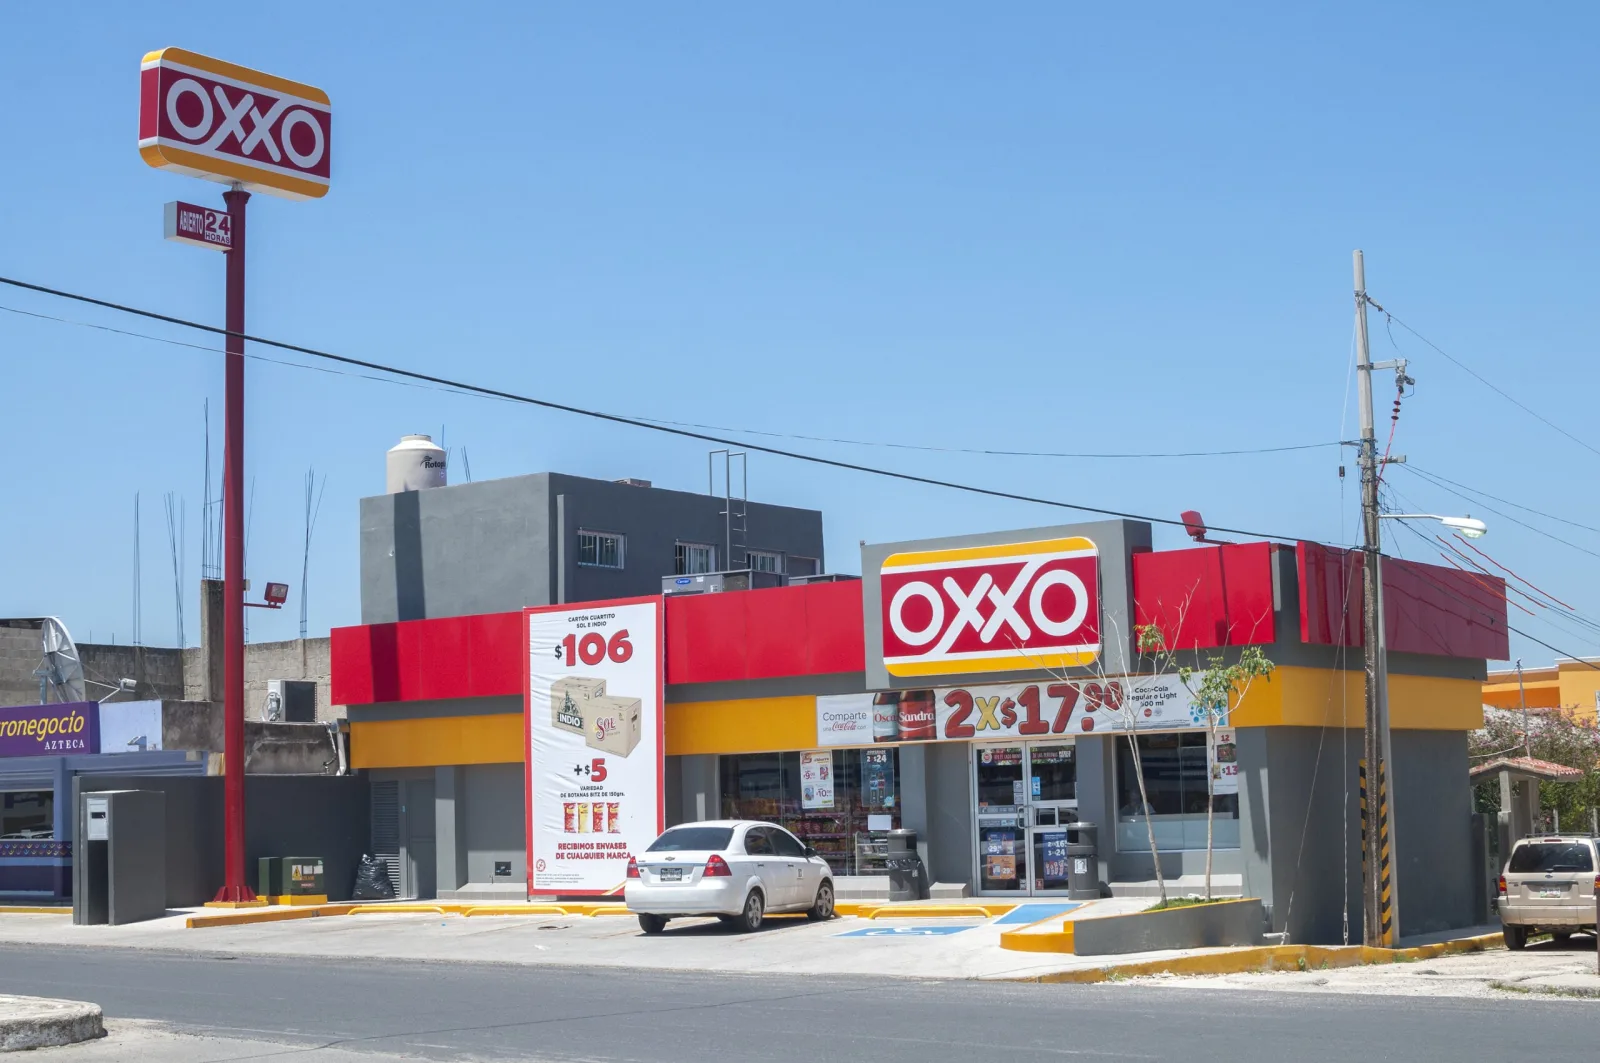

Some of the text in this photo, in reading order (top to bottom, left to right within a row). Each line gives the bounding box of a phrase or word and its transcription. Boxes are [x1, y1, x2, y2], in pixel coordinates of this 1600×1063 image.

[166, 78, 324, 168] OXXO
[180, 209, 230, 236] ABIERTO 24
[205, 231, 230, 244] HORAS
[889, 560, 1088, 652] OXXO
[568, 614, 589, 622] CARTÓN
[554, 629, 633, 667] $106
[1160, 692, 1177, 700] Light
[559, 713, 580, 727] INDIO
[823, 711, 867, 722] Comparte
[899, 710, 934, 722] Sandra
[0, 710, 85, 742] ronegocio
[832, 720, 857, 731] Coca-Cola
[1221, 734, 1230, 742] 12
[44, 739, 85, 750] AZTECA
[566, 852, 605, 860] CUALQUIER
